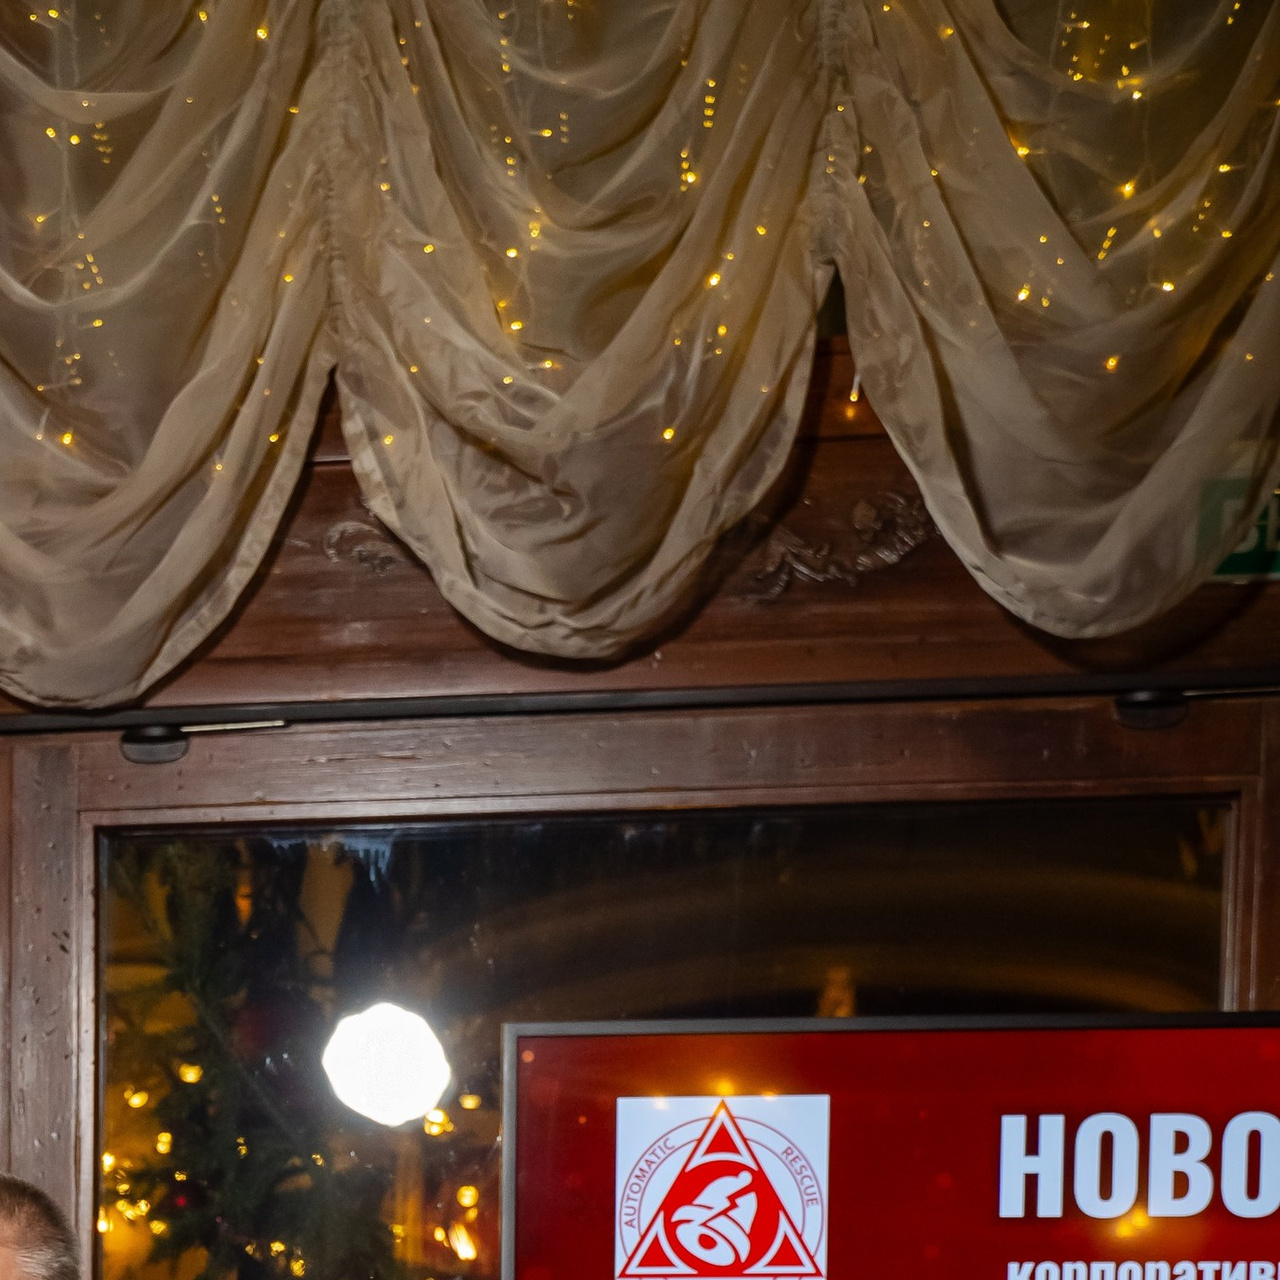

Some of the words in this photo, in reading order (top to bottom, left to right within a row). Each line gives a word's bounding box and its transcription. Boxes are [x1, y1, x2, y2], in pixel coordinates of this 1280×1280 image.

[623, 1136, 677, 1229] AUTOMATIC
[780, 1145, 820, 1208] RESCUE
[998, 1111, 1280, 1219] НОВО
